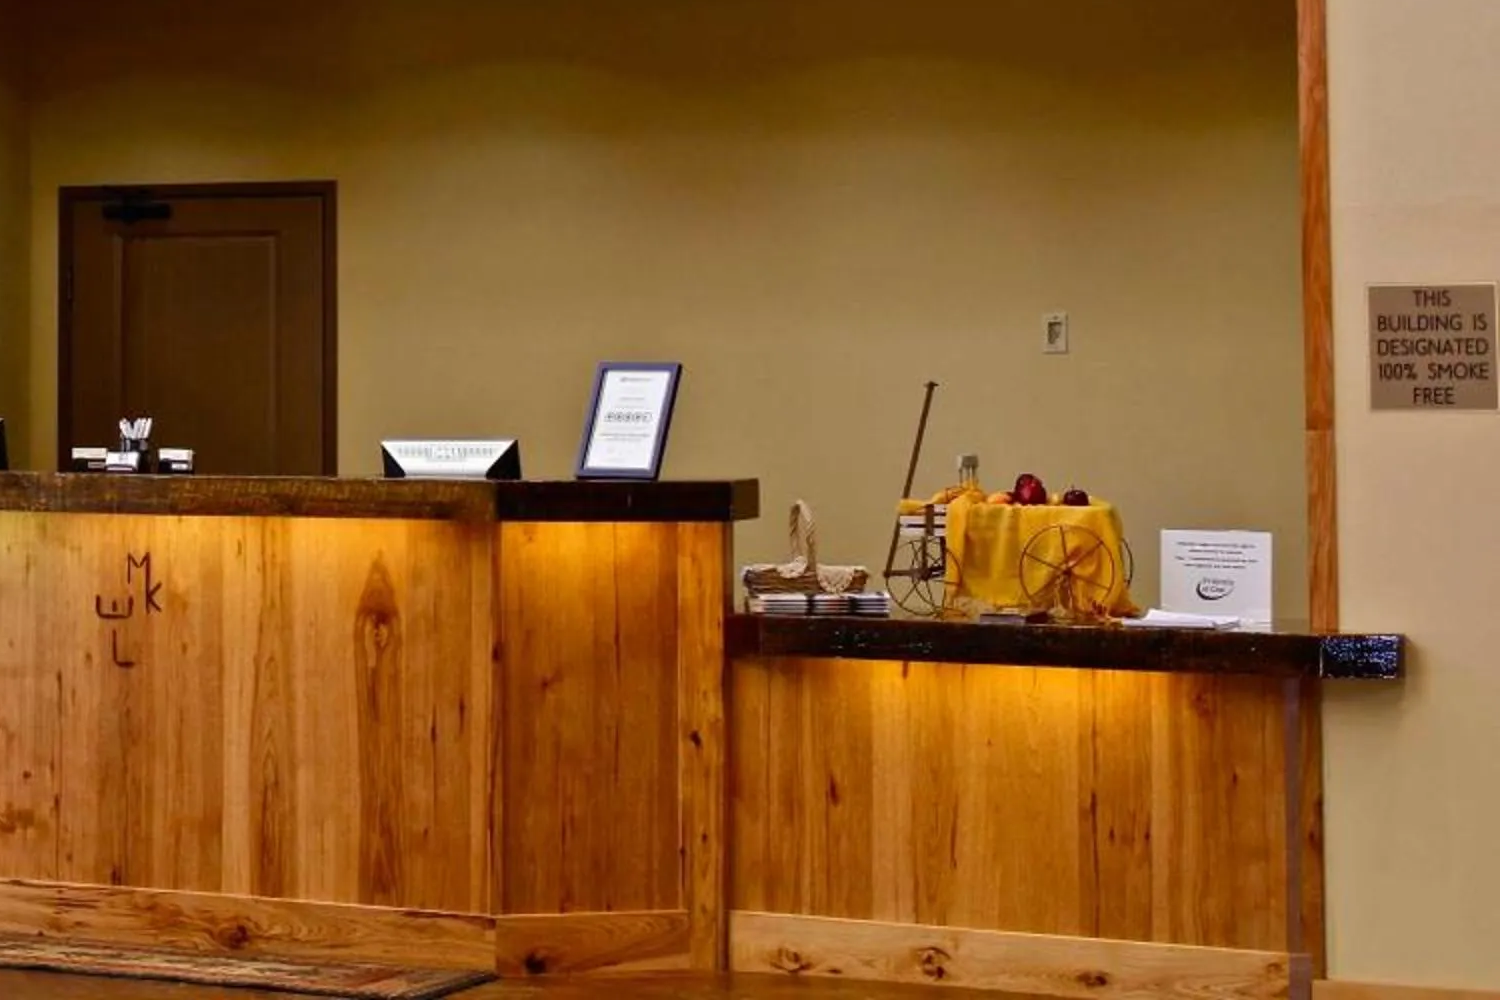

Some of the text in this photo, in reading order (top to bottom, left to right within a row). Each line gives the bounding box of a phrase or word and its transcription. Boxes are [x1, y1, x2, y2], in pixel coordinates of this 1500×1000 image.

[1412, 290, 1452, 307] THIS
[1377, 313, 1488, 332] BUILDING IS
[1377, 338, 1489, 356] DESIGNATED
[1379, 362, 1489, 381] 100% SMOKE
[1413, 387, 1456, 405] FREE
